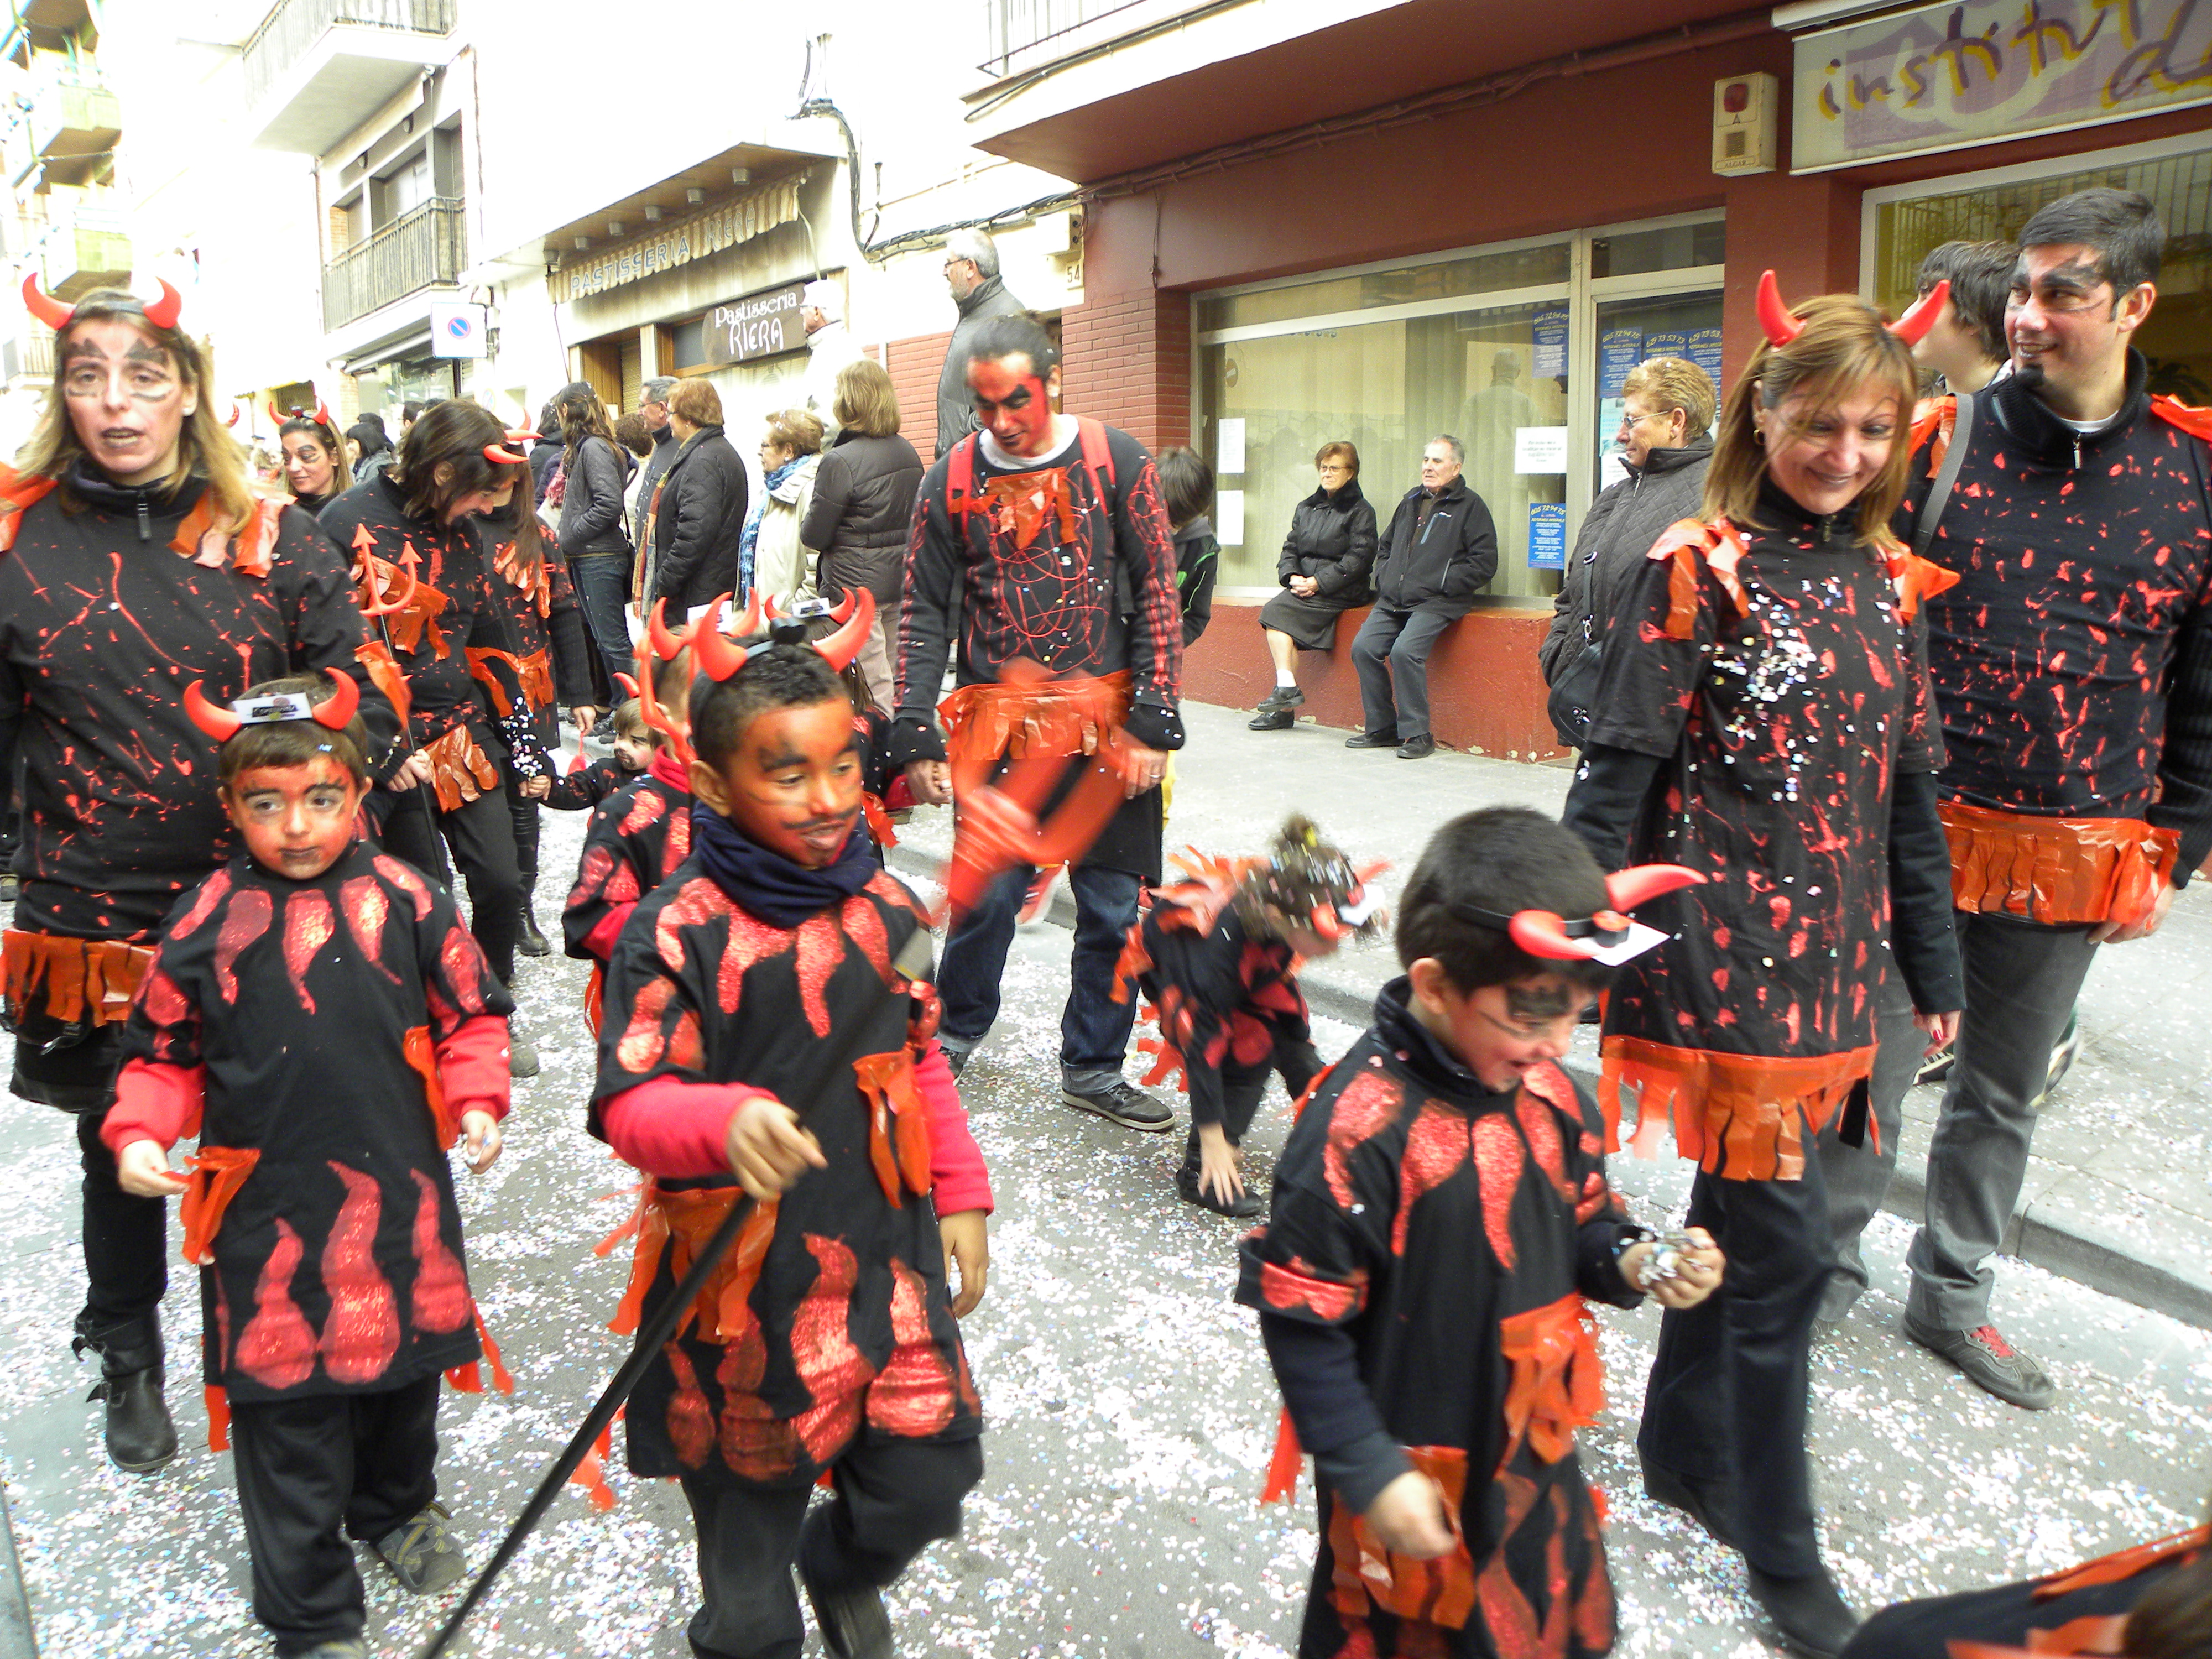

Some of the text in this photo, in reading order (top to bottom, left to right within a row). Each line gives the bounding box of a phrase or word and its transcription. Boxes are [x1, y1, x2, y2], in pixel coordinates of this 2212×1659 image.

[571, 237, 691, 293] PASTISSERIA
[1067, 264, 1080, 283] 54
[715, 289, 797, 328] Pastisseria
[729, 317, 784, 359] RIERA
